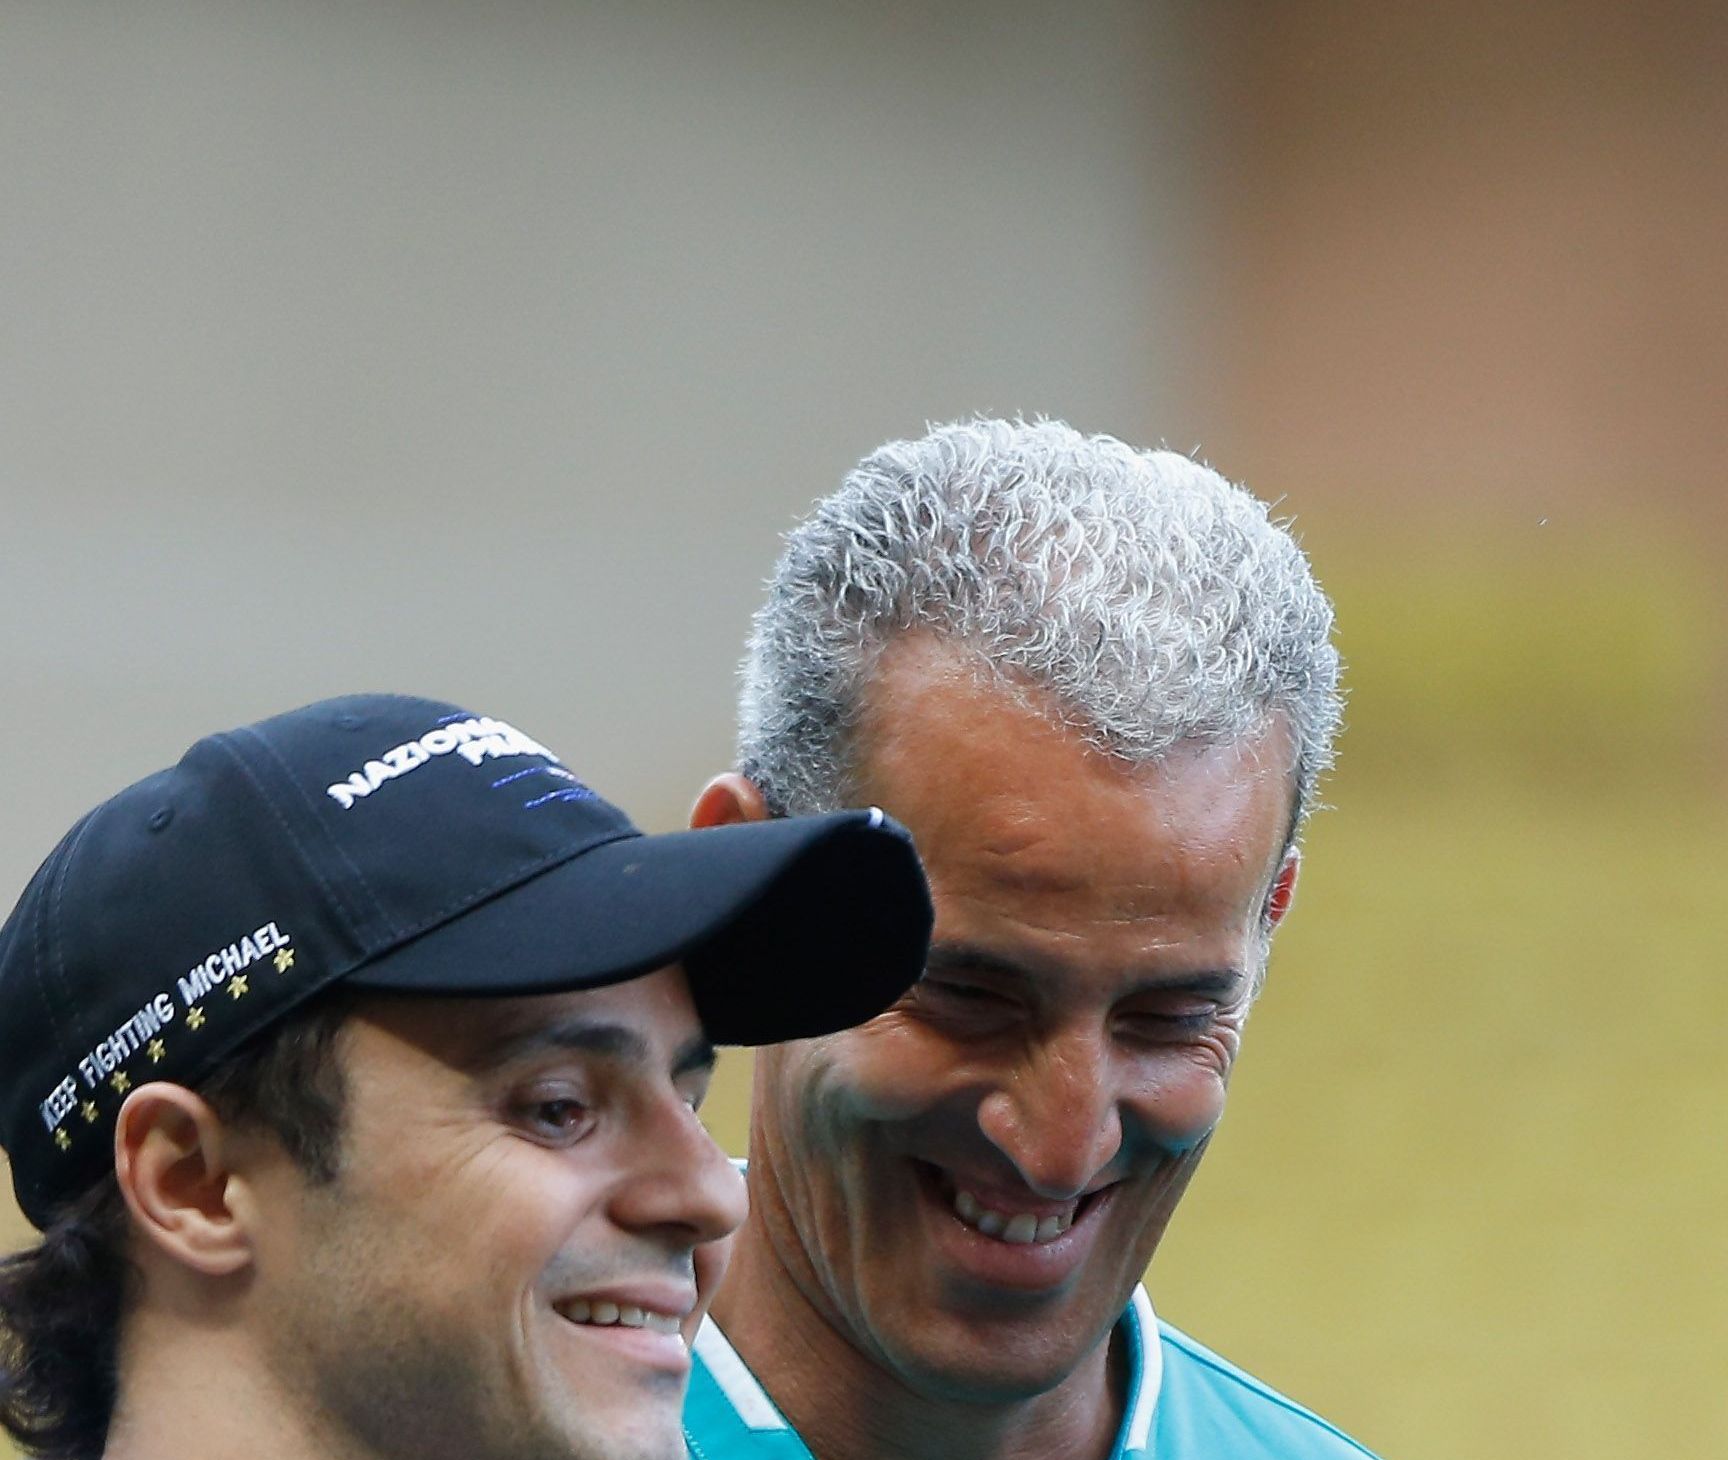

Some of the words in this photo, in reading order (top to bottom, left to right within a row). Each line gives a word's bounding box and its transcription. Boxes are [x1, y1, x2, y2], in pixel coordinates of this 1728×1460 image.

[38, 1073, 78, 1133] KEEP
[78, 993, 175, 1089] FIGHTING
[177, 921, 291, 1006] MICHAEL
